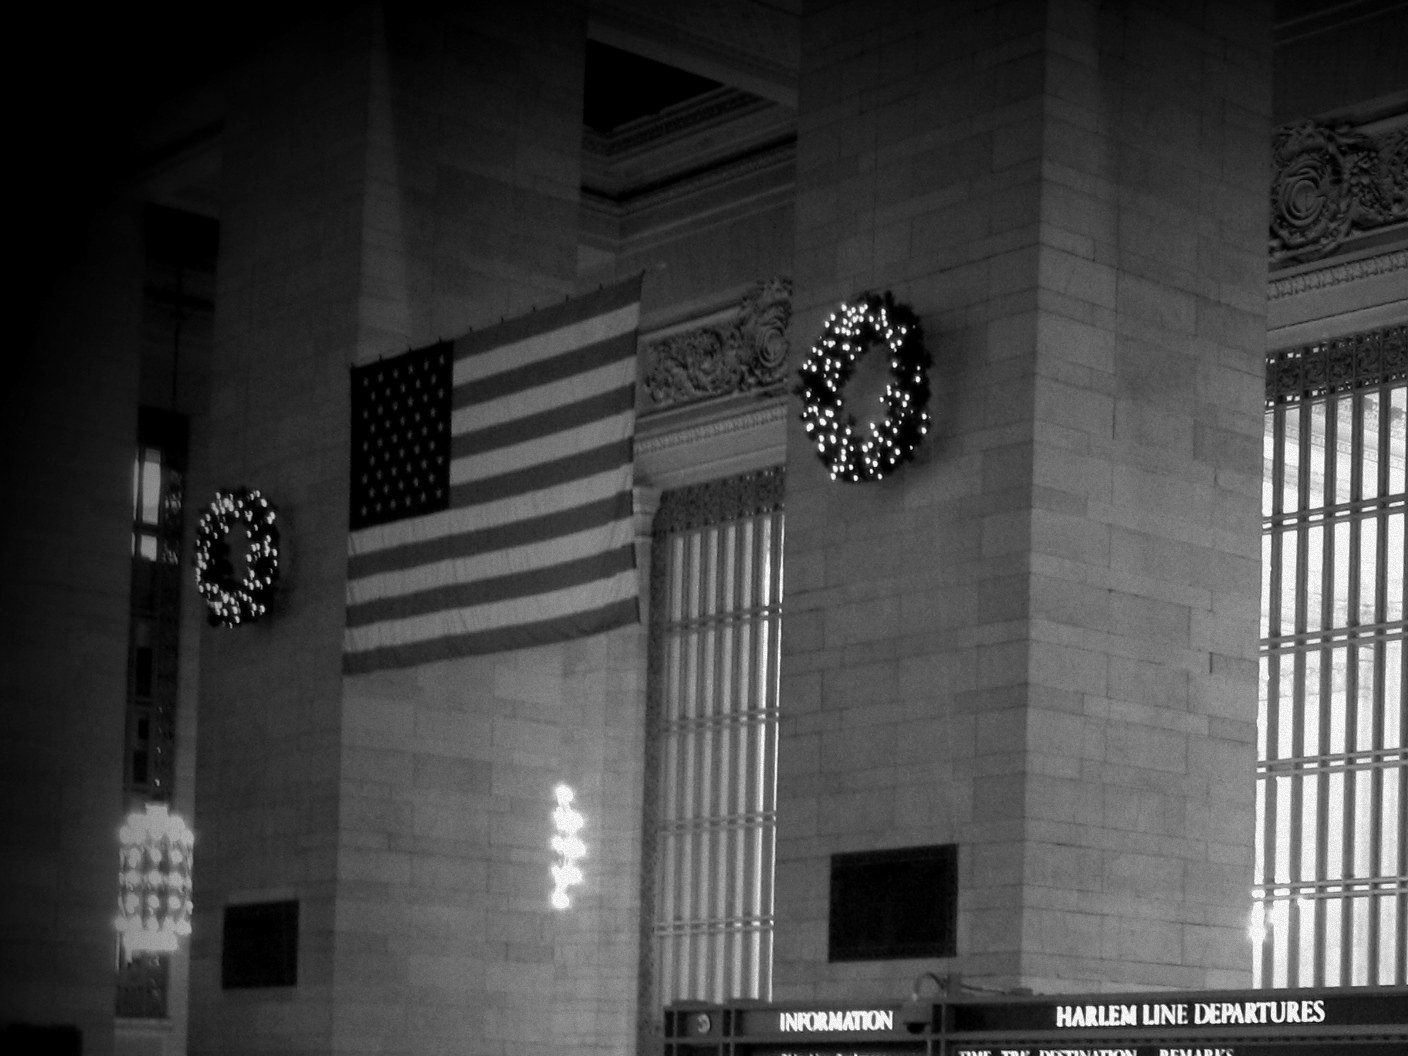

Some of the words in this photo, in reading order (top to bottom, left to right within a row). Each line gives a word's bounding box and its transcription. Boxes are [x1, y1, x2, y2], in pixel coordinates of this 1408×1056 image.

[779, 1009, 894, 1033] INFORMATION
[1055, 1004, 1138, 1028] HARLEM
[1142, 1003, 1189, 1026] LINE
[1194, 999, 1326, 1025] DEPARTURES
